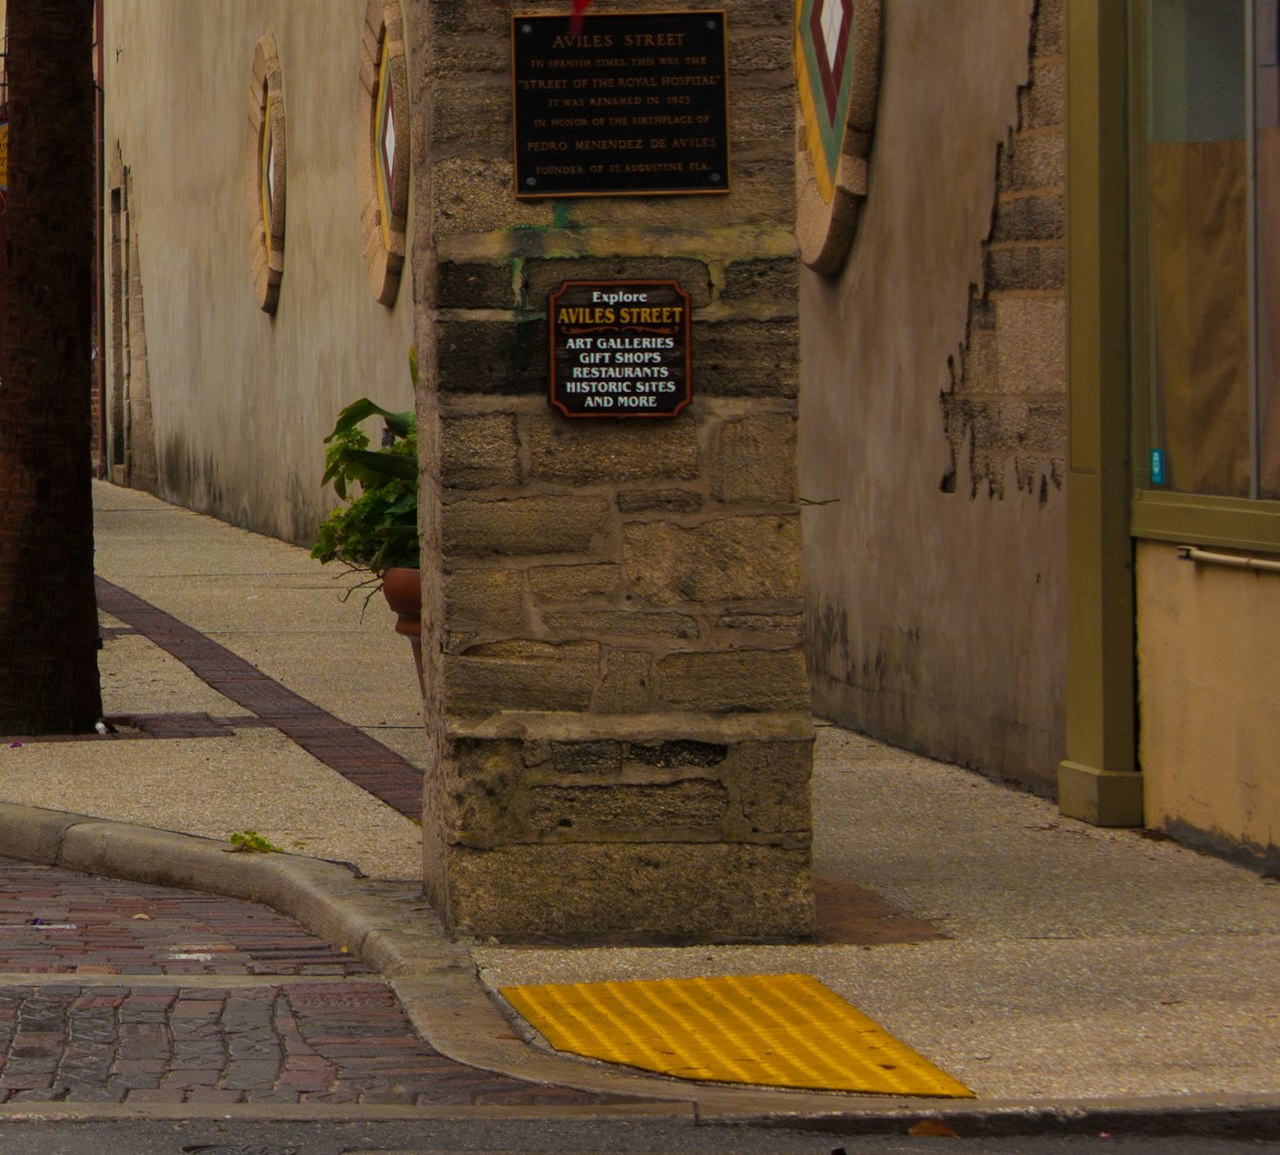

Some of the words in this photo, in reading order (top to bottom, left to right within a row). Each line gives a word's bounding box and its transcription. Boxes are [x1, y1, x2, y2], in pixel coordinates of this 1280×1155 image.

[553, 35, 613, 49] AVILES
[624, 33, 685, 46] STREET
[531, 59, 544, 68] IN
[548, 59, 591, 68] SPANISH
[632, 58, 655, 66] THIS
[659, 57, 679, 66] WAS
[686, 57, 707, 65] THE
[573, 79, 588, 88] OF
[592, 78, 615, 88] THE
[618, 77, 657, 87] ROYAL
[548, 99, 559, 107] IT
[562, 99, 584, 107] WAS
[589, 97, 641, 106] RENAMED
[646, 97, 659, 105] IN
[534, 119, 546, 127] IN
[551, 118, 588, 127] HONOR
[592, 118, 605, 126] OF
[608, 117, 628, 125] THE
[632, 116, 693, 125] BIRTHPLACE
[696, 115, 710, 124] OF
[527, 141, 568, 151] PEDRO
[575, 139, 643, 150] MENENDEZ
[651, 139, 667, 148] DE
[672, 138, 716, 148] AVILES
[536, 166, 584, 175] FOUNDER
[590, 165, 604, 173] OF
[624, 163, 683, 173] AUGUSTINE
[592, 292, 647, 305] Explore
[559, 309, 615, 324] AVILES
[620, 308, 683, 323] STREET
[566, 338, 593, 349] ART
[597, 338, 674, 349] GALLERIES
[579, 353, 611, 364] GIFT
[615, 353, 661, 363] SHOPS
[573, 367, 669, 378] RESTAURANTS
[566, 382, 632, 393] HISTORIC
[635, 381, 676, 393] SITES
[584, 396, 613, 407] AND
[617, 396, 657, 407] MORE
